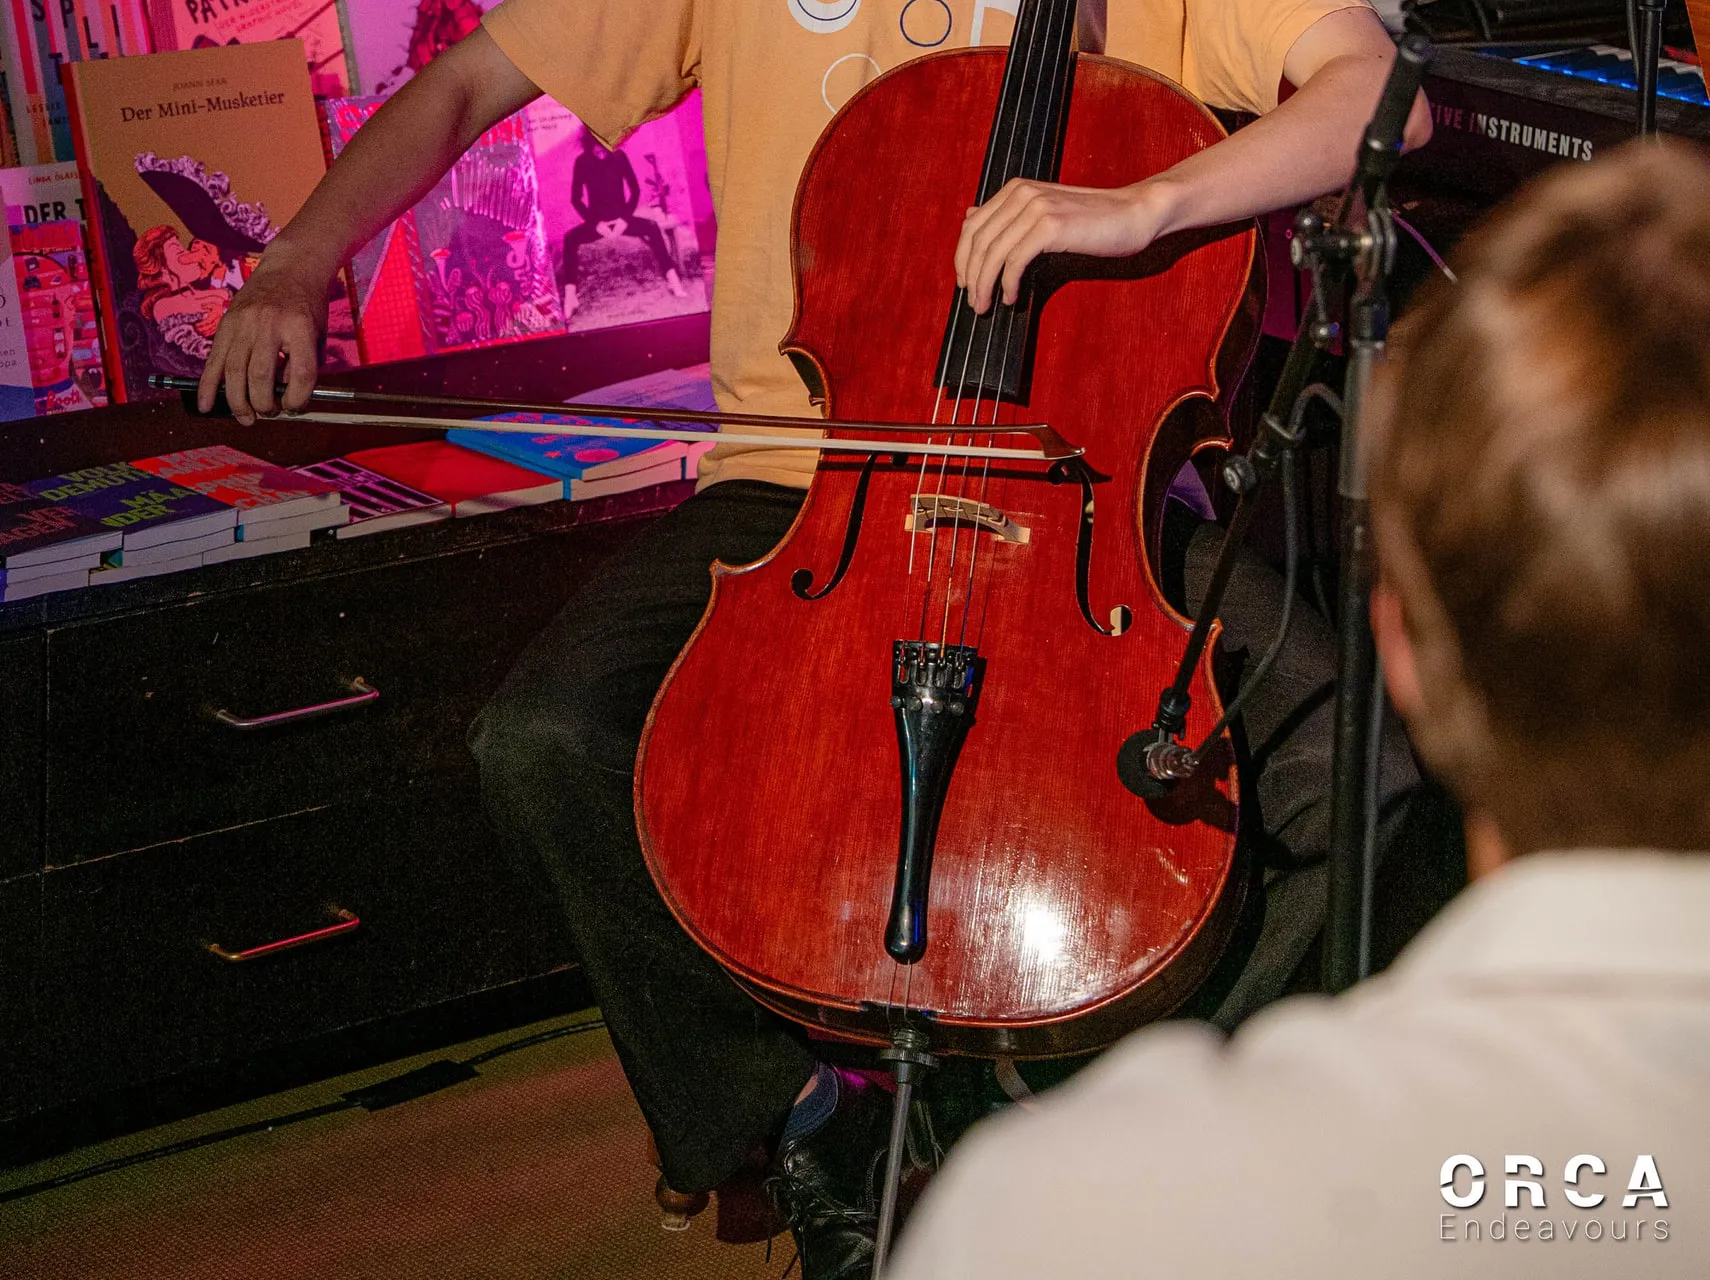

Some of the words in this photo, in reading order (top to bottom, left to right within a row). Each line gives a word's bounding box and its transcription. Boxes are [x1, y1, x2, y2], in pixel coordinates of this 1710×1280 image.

[120, 107, 153, 122] Der
[158, 90, 286, 119] Mini-Musketier
[1468, 112, 1593, 162] INSTRUMENTS
[24, 200, 66, 225] DER
